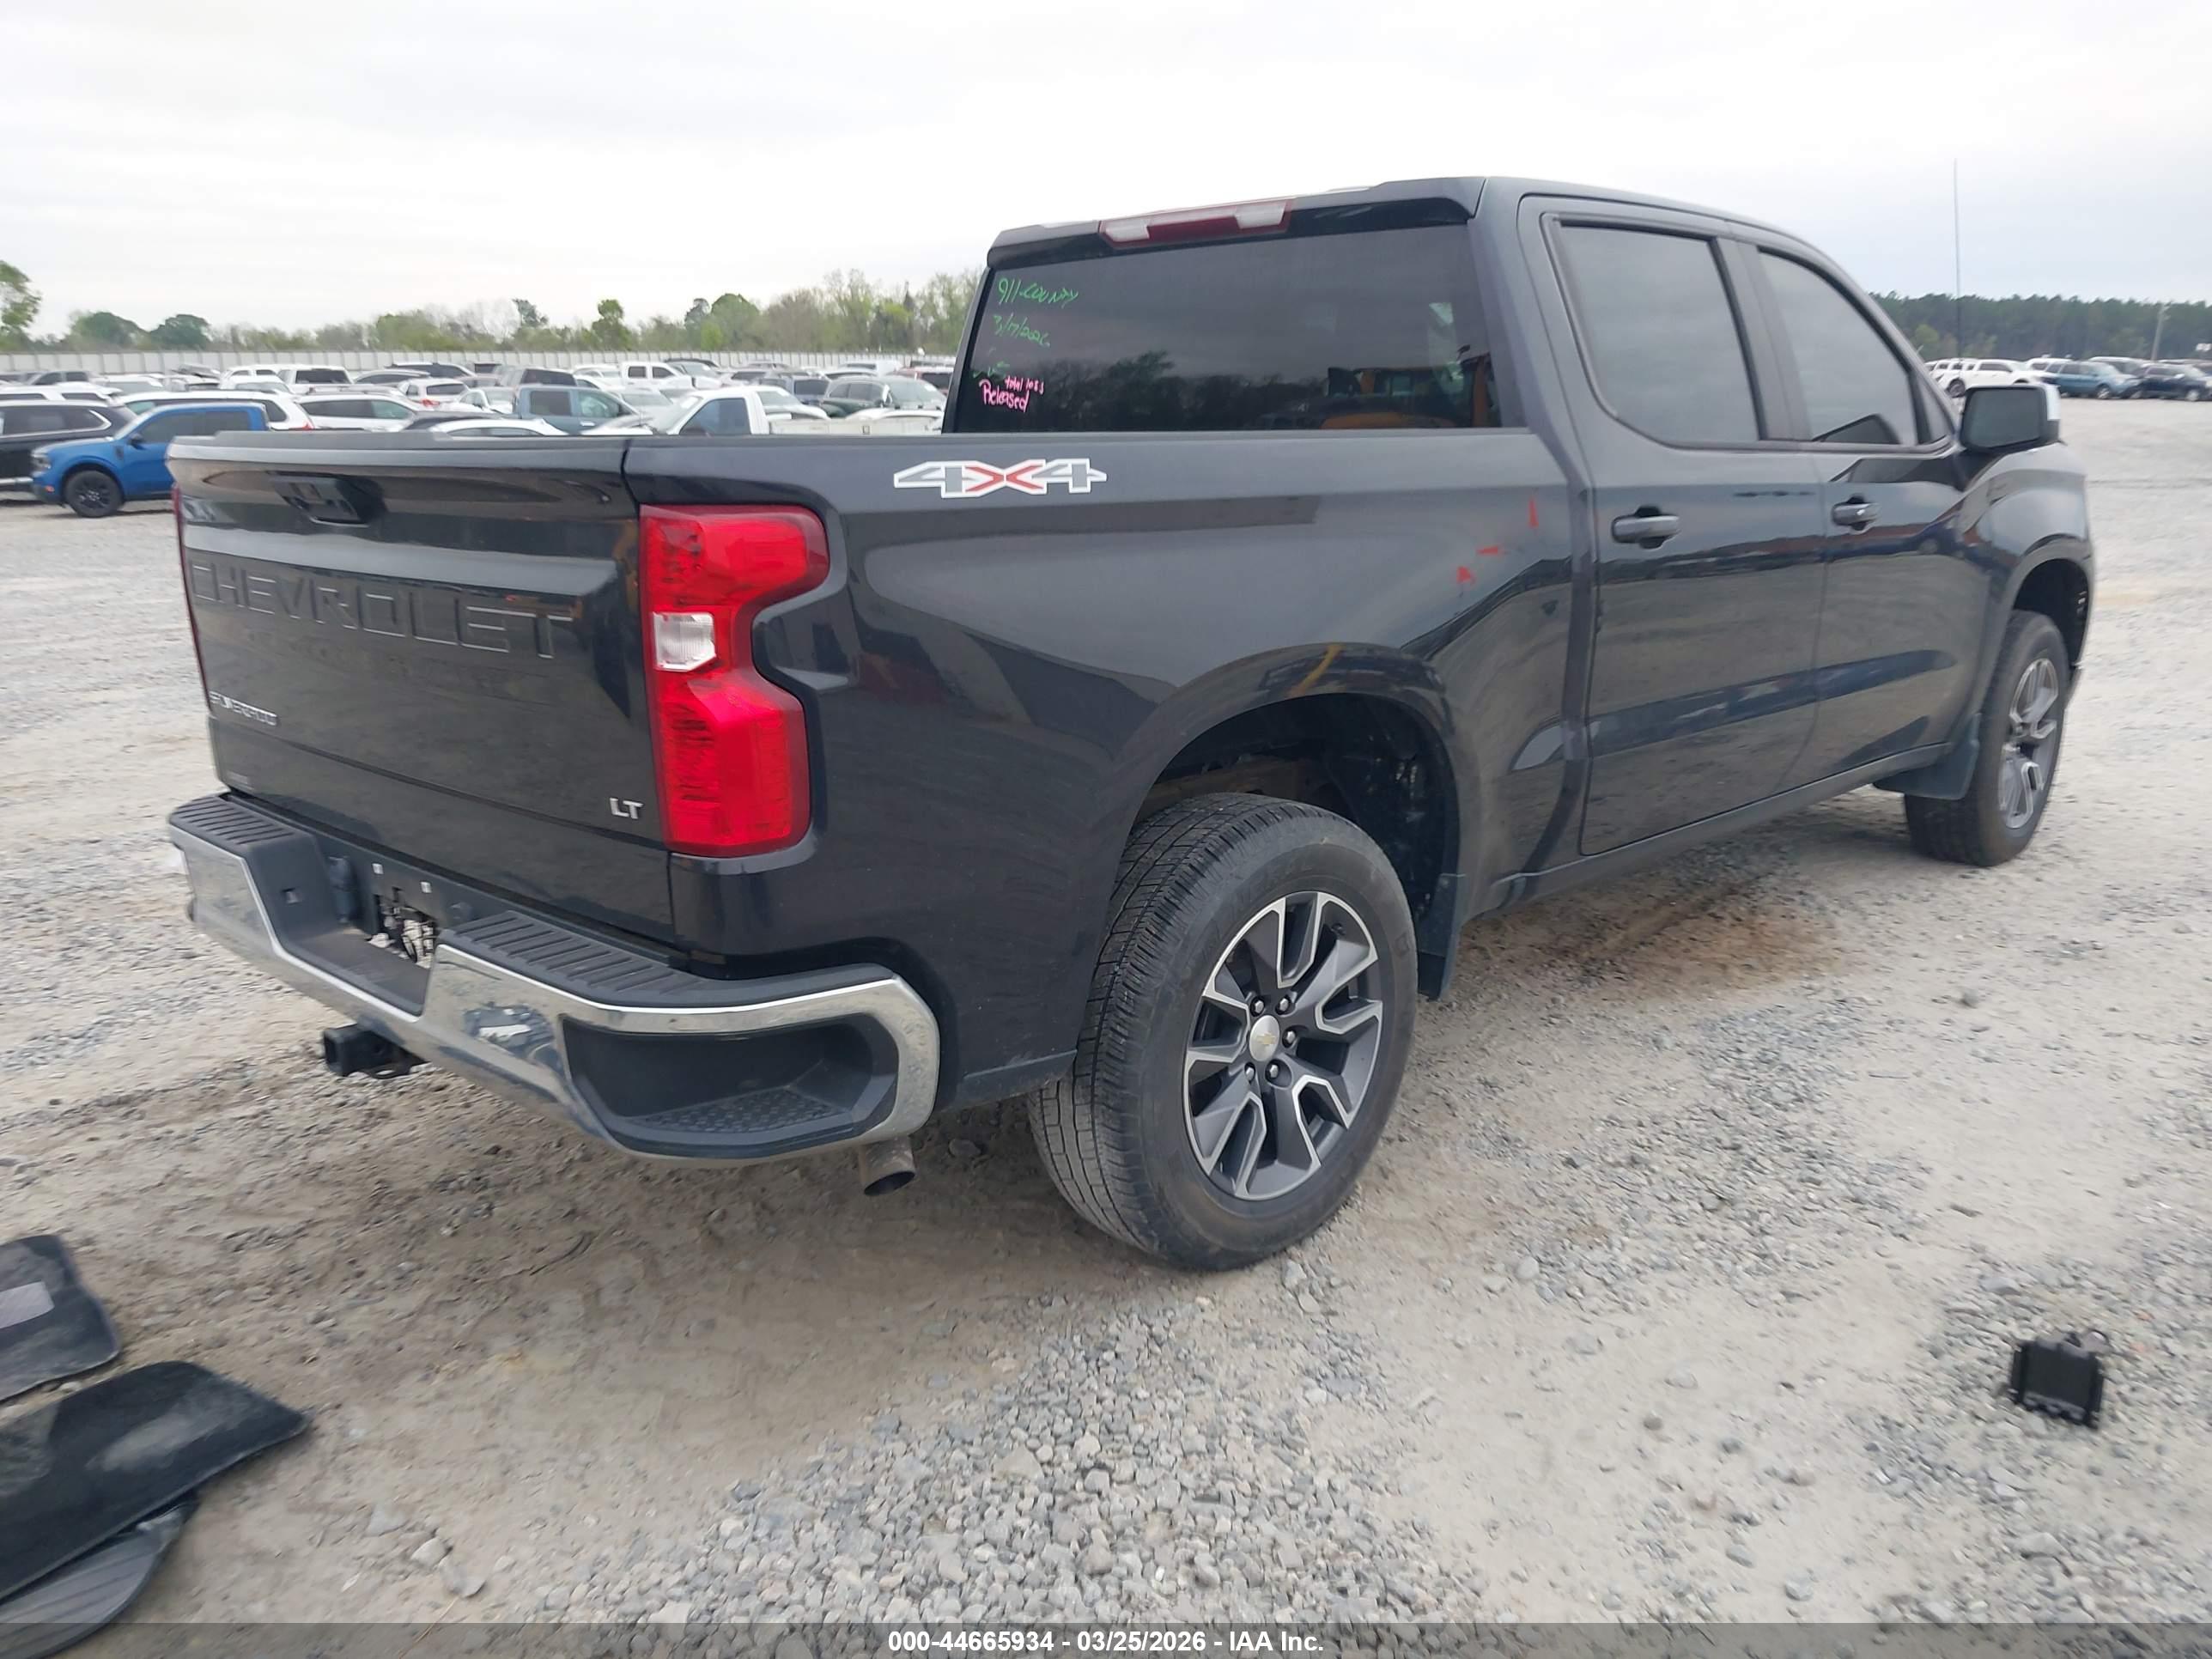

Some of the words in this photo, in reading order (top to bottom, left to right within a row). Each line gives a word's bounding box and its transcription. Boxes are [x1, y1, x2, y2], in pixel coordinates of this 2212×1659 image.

[980, 380, 1030, 412] Released
[190, 562, 573, 659] CHEVROLET
[609, 797, 644, 819] LT
